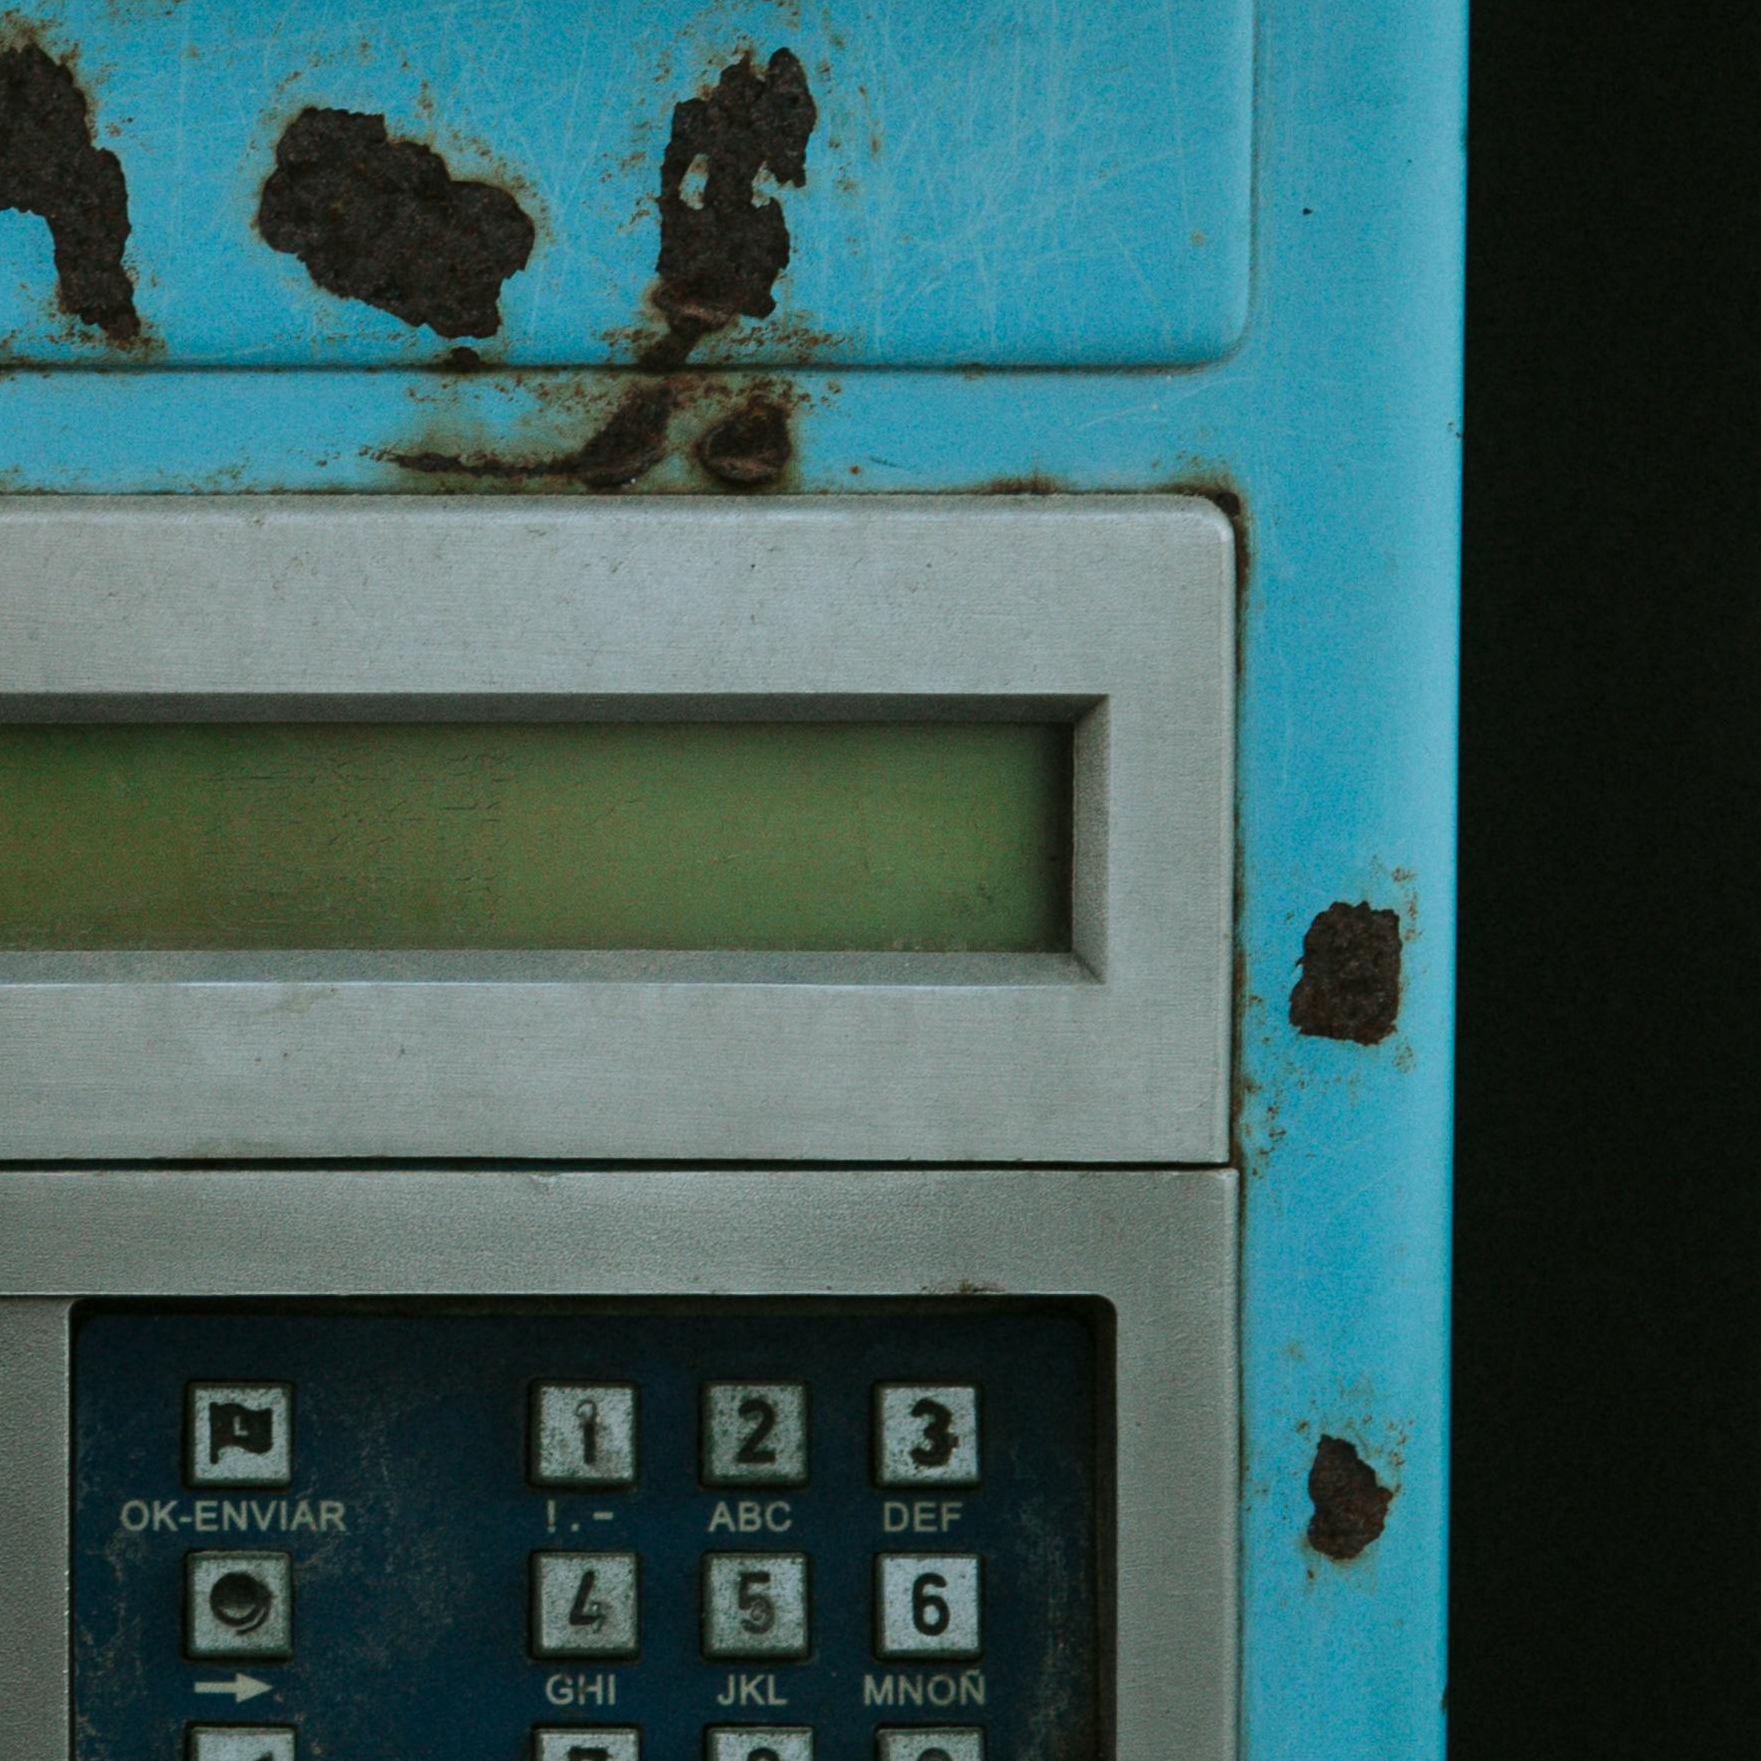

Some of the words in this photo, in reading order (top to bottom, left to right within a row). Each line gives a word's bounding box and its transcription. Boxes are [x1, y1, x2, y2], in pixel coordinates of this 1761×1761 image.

[575, 1399, 599, 1466] 1
[737, 1397, 778, 1466] 2
[909, 1397, 960, 1467] 3
[120, 1499, 347, 1532] OK-ENVIAR
[708, 1501, 792, 1533] ABC
[883, 1501, 963, 1533] DEF
[567, 1569, 609, 1635] 4
[736, 1570, 773, 1635] 5
[911, 1571, 951, 1637] 6
[545, 1674, 616, 1706] GHI
[717, 1674, 788, 1706] JKL
[863, 1669, 986, 1706] MNOÑ
